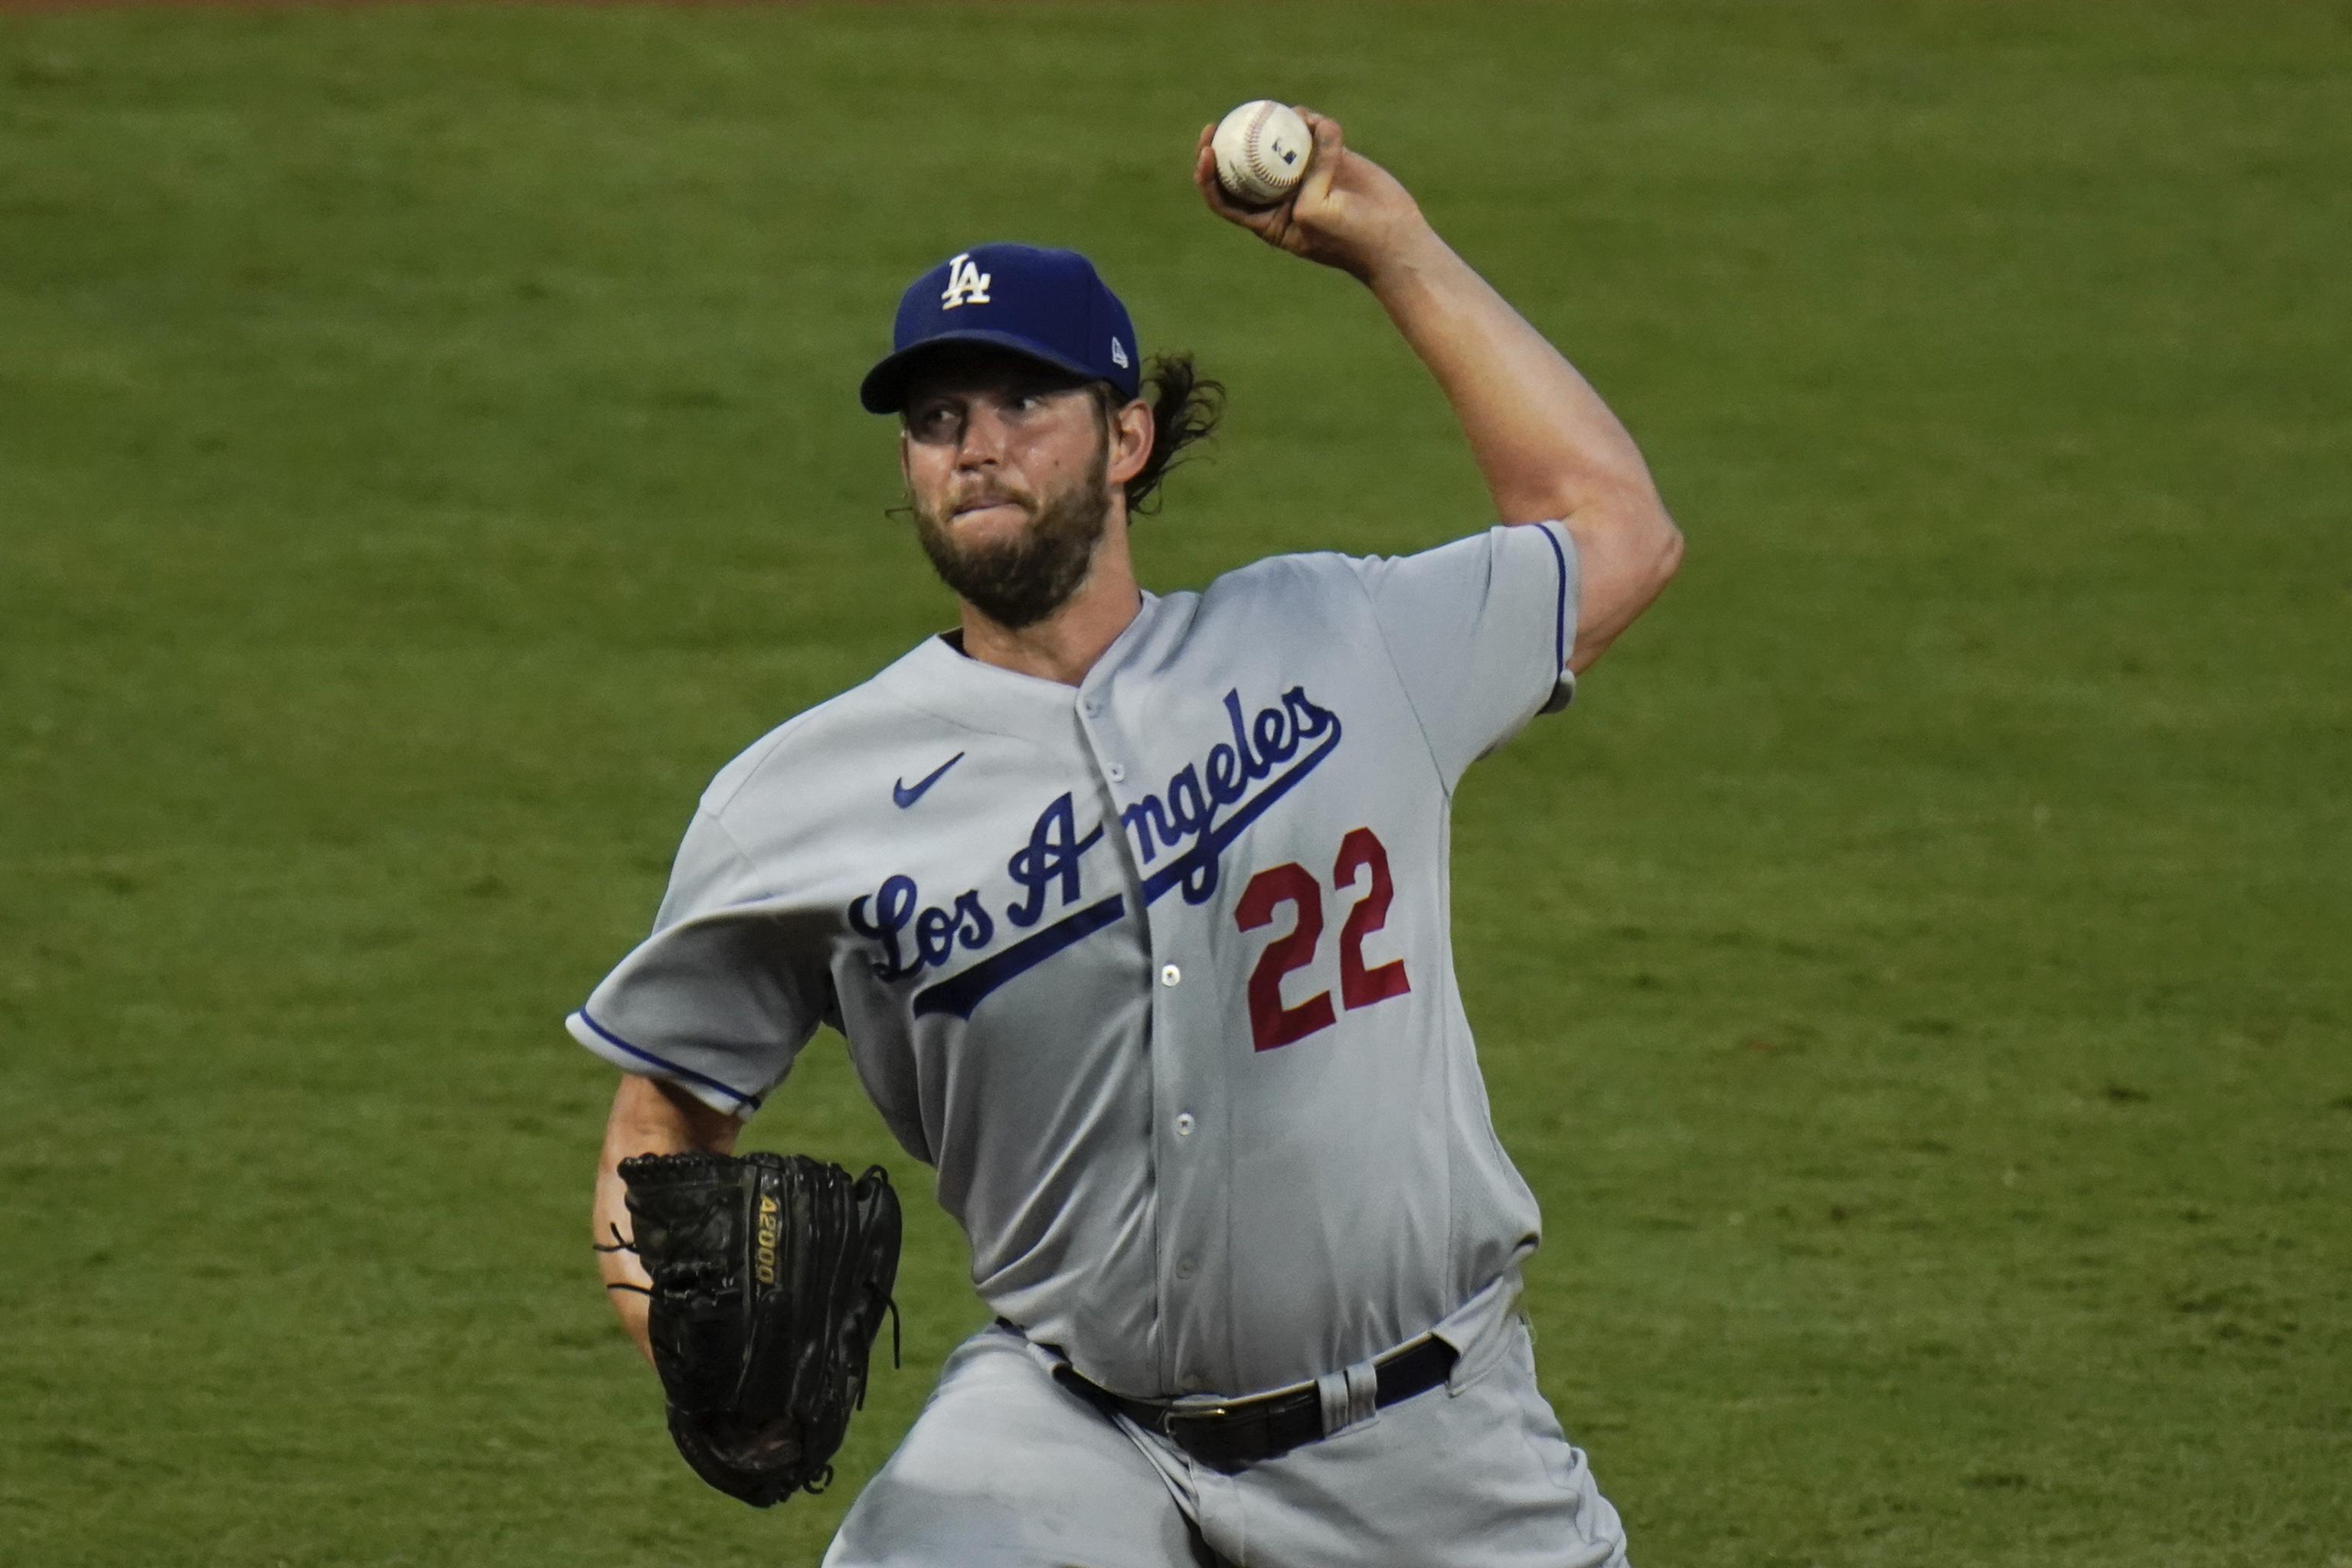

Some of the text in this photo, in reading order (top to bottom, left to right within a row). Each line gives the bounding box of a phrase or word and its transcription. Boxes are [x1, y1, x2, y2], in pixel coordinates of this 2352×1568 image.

[942, 253, 991, 310] LA
[848, 685, 1341, 982] Los Angeles
[1234, 827, 1411, 1053] 22
[757, 1195, 779, 1283] A2000
